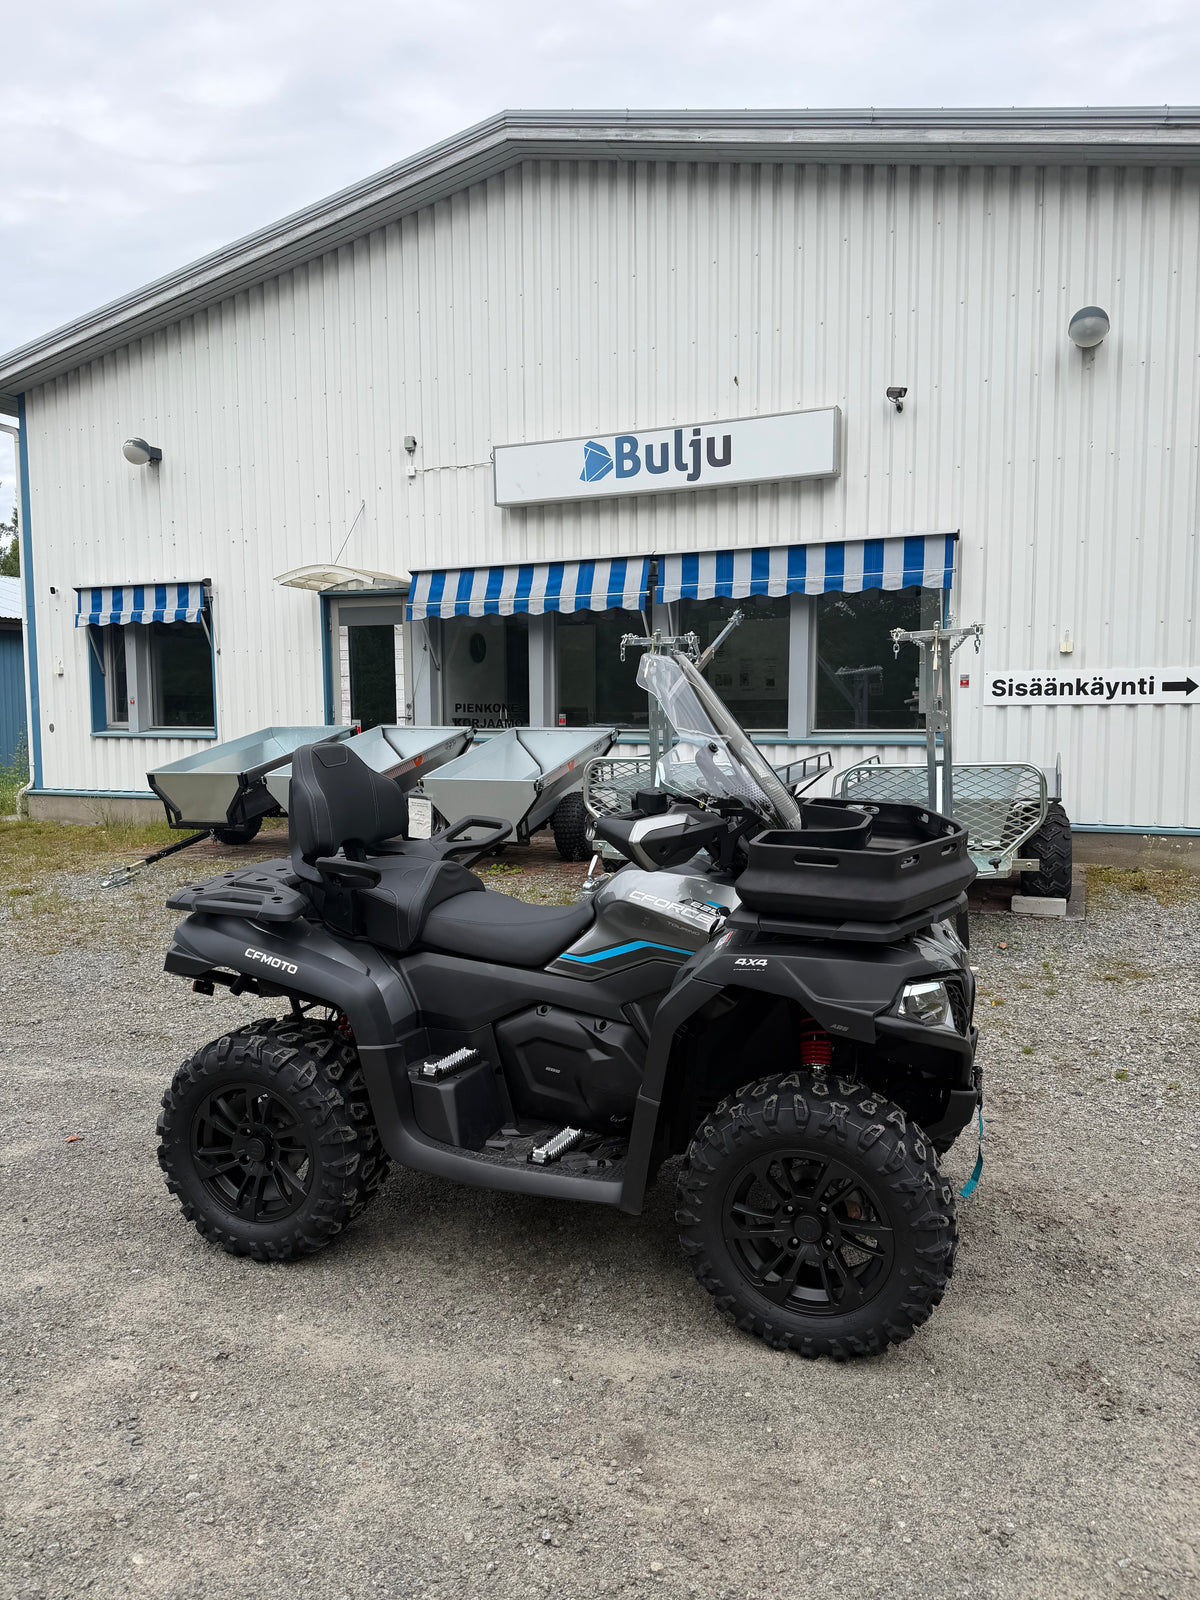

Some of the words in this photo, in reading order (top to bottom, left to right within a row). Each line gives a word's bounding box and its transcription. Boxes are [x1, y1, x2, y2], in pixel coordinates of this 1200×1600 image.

[615, 428, 732, 482] Bulju
[991, 676, 1155, 701] Sisäänkäynti
[628, 890, 717, 925] CFORCE
[244, 947, 299, 975] CFMOTO
